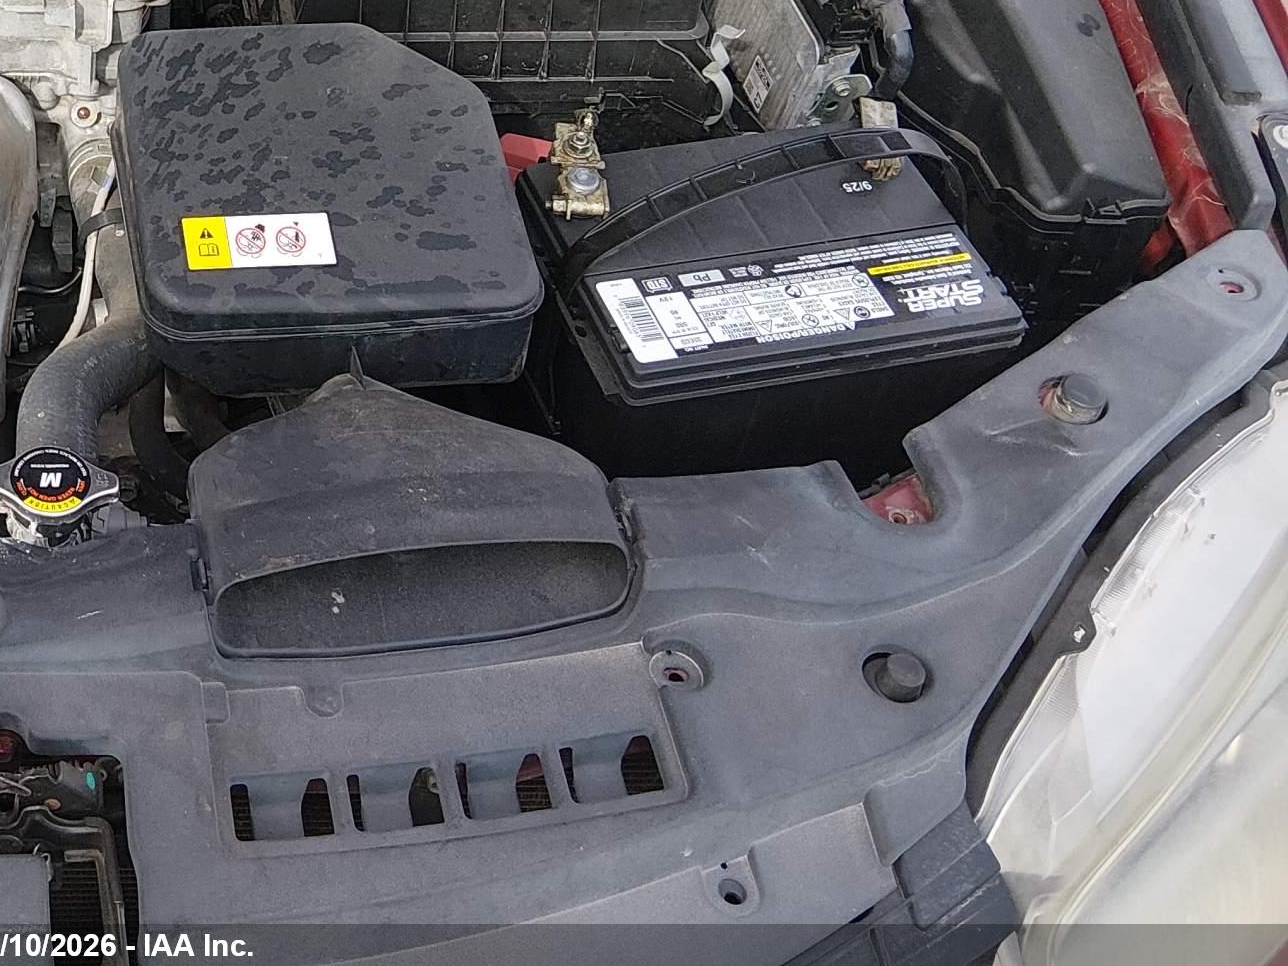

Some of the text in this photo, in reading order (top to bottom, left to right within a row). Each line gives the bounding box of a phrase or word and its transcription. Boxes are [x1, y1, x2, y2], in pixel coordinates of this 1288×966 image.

[841, 180, 872, 193] 9/25
[692, 273, 711, 283] Pb
[907, 294, 983, 313] SUPER
[755, 323, 847, 344] DANGER/POISON
[39, 472, 63, 488] M
[29, 499, 69, 511] CAUTION
